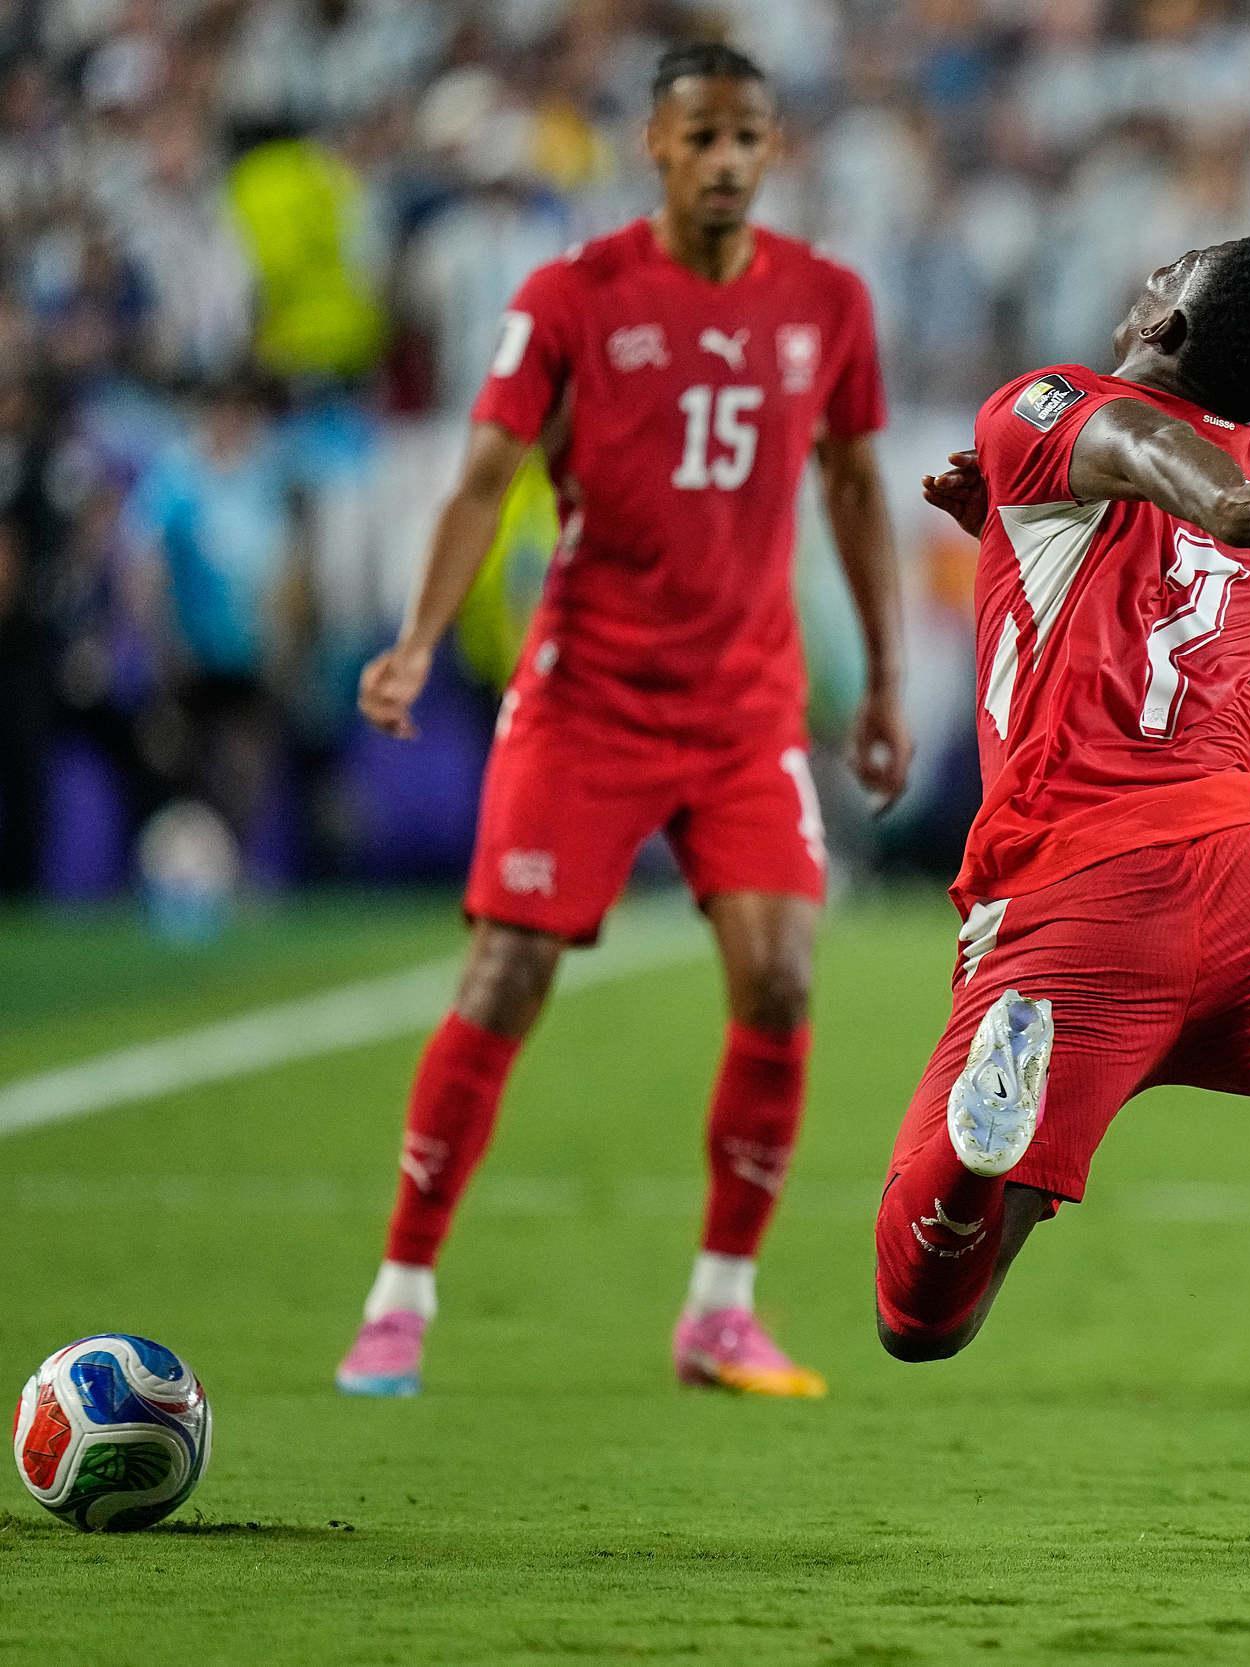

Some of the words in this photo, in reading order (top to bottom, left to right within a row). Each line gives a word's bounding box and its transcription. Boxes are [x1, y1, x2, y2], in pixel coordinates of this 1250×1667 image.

[672, 384, 765, 491] 15
[1203, 415, 1235, 430] suisse
[1140, 527, 1250, 740] 7
